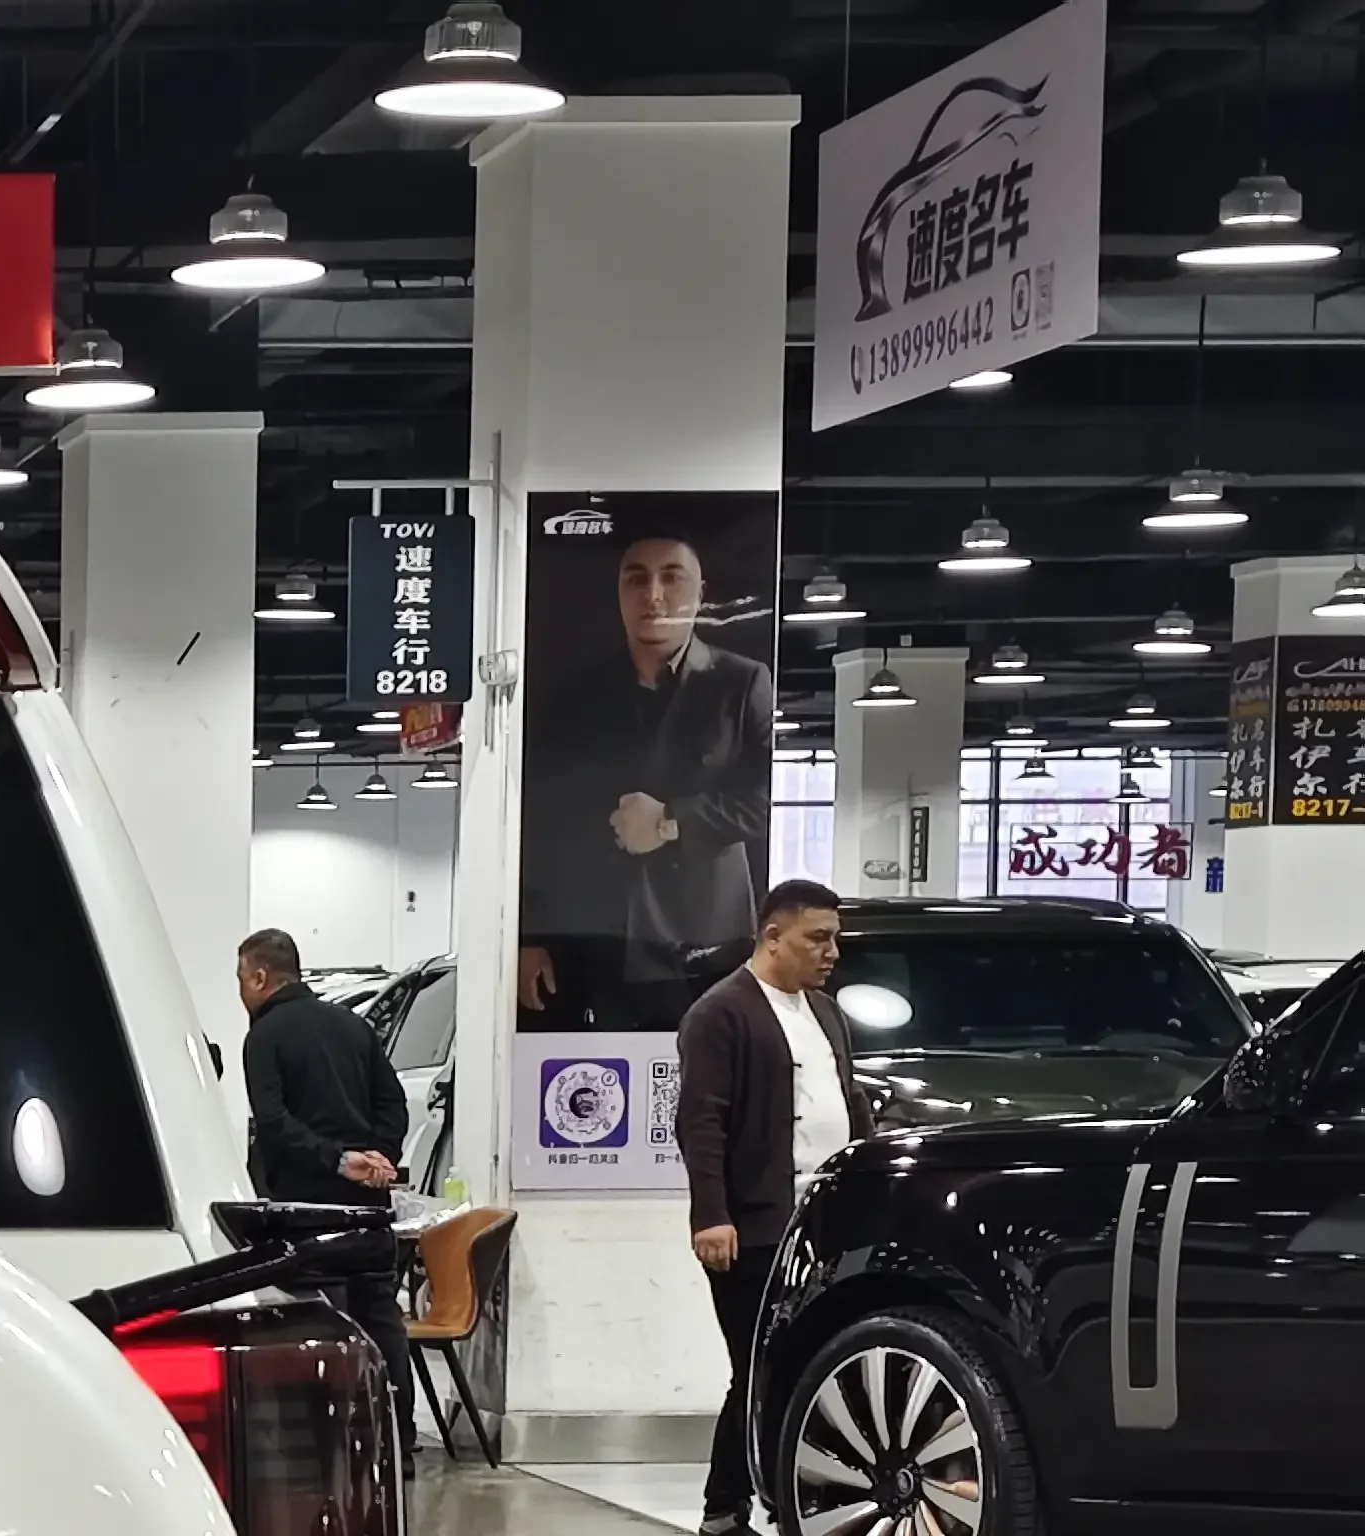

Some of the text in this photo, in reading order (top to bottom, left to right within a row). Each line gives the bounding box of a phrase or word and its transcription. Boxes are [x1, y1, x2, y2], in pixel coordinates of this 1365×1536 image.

[903, 157, 1034, 305] 速度名车
[868, 297, 995, 385] 13899996442
[392, 545, 433, 665] 速度车行
[376, 669, 448, 694] 8218
[1010, 823, 1191, 879] 成功者
